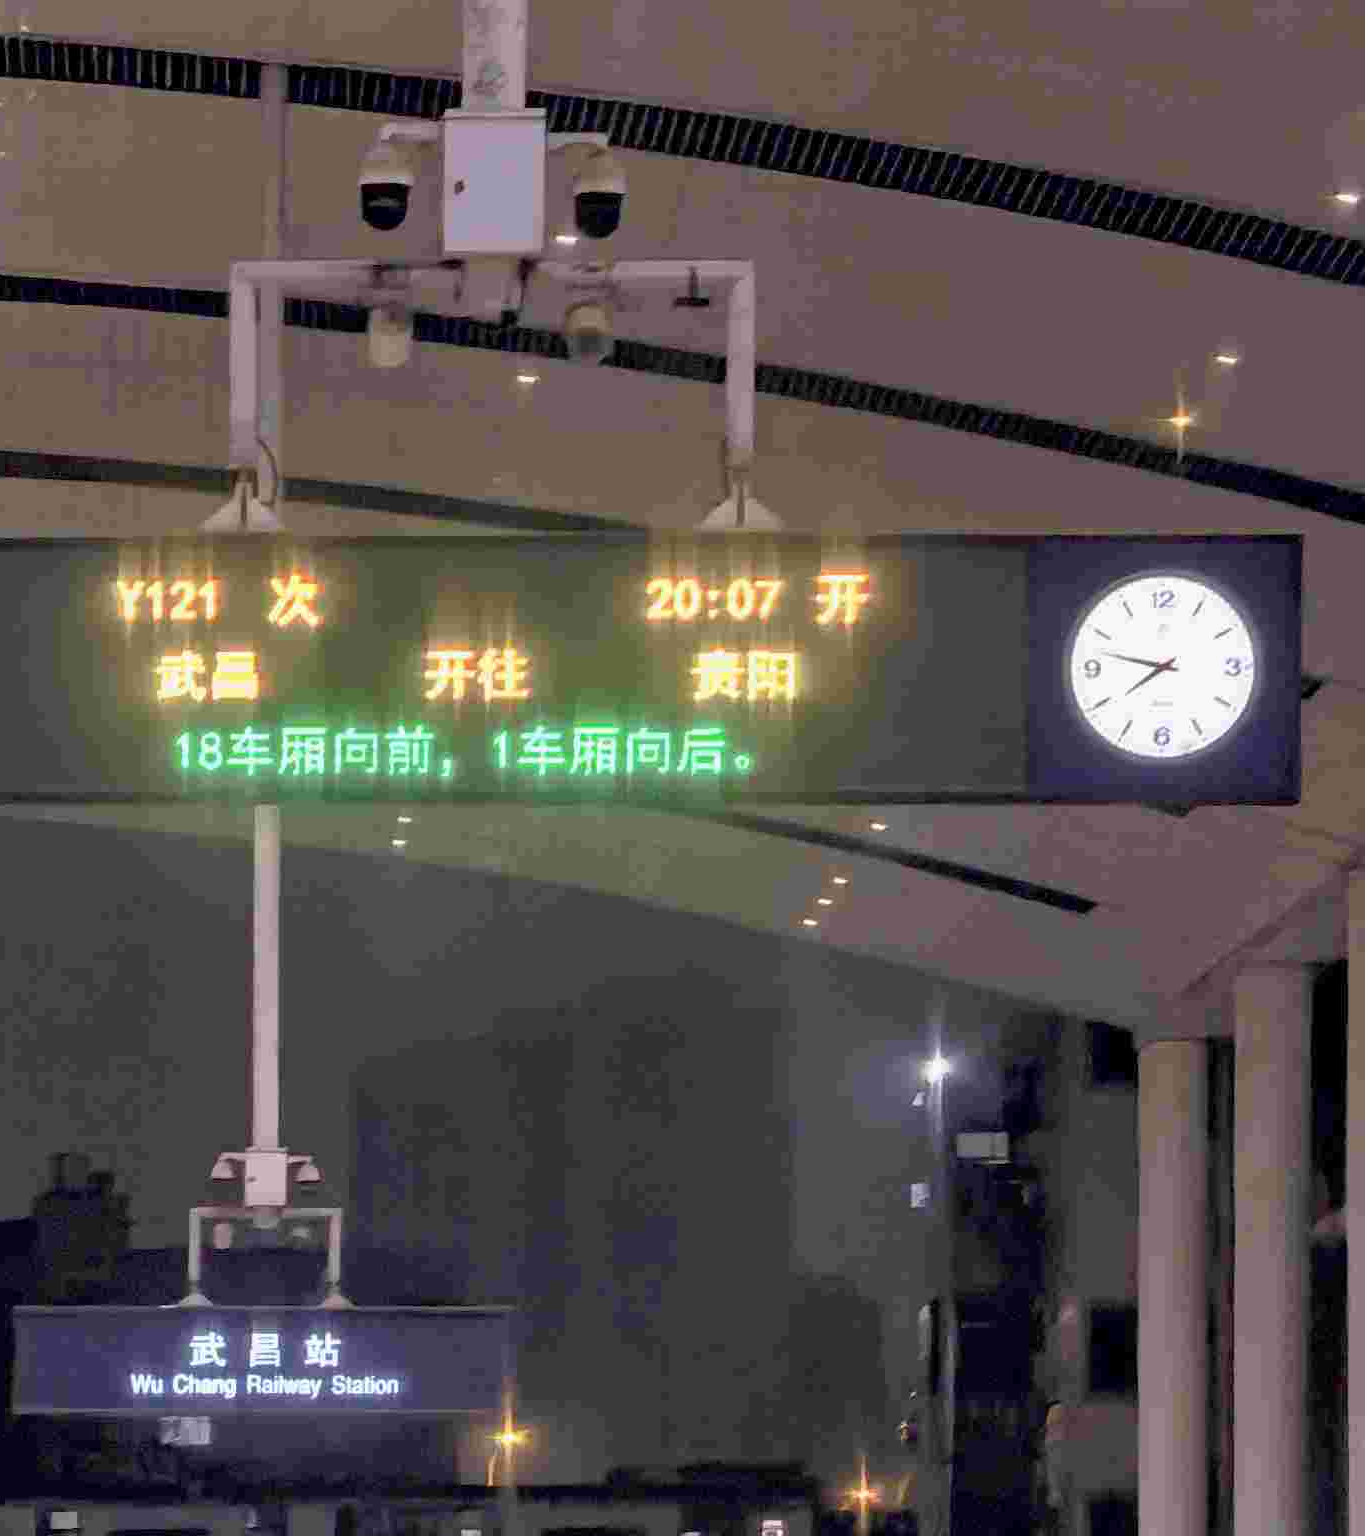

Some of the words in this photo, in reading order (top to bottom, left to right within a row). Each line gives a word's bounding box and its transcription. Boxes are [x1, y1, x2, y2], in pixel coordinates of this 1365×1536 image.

[117, 579, 219, 620] Y121
[268, 572, 320, 627] 次
[646, 577, 783, 620] 20:07
[815, 573, 869, 625] 开
[1152, 590, 1175, 609] 12
[154, 649, 259, 701] 武昌
[424, 645, 532, 701] 开往
[690, 649, 800, 701] 贵阳
[1084, 659, 1101, 679] 9
[1224, 659, 1241, 677] 3
[1154, 727, 1171, 746] 6
[189, 1332, 341, 1367] 武昌站
[130, 1374, 164, 1394] Wu
[173, 1374, 237, 1399] Chang
[246, 1374, 322, 1399] Railway
[331, 1374, 400, 1395] Station
